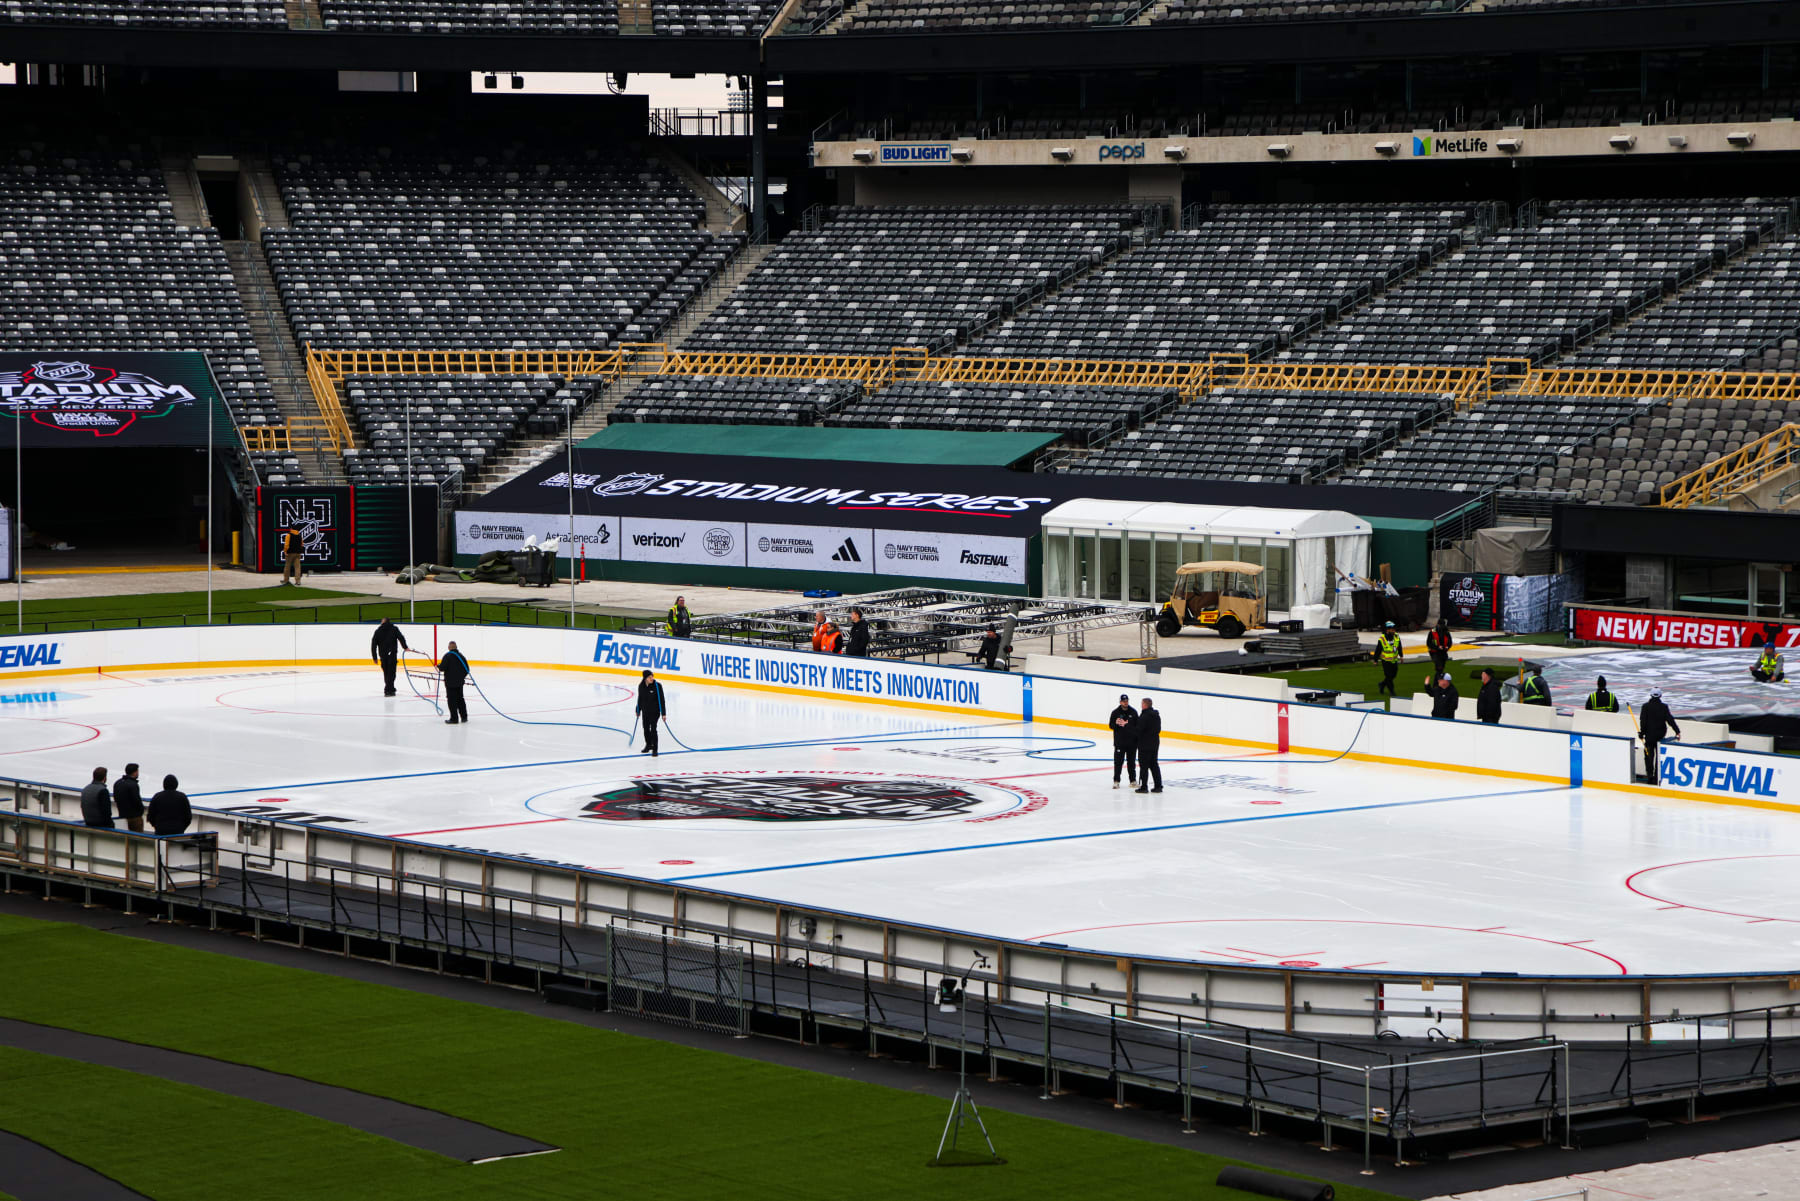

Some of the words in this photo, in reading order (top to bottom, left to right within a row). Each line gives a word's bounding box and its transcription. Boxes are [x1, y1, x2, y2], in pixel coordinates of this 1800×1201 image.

[1099, 142, 1145, 162] pepsi
[1436, 138, 1488, 152] MetLife
[883, 147, 909, 160] BUD
[911, 147, 948, 160] LIGHT
[49, 365, 83, 378] NHL
[0, 396, 161, 405] SERIES
[643, 479, 865, 505] STADIUM
[846, 492, 1051, 511] SERIES
[280, 499, 331, 527] NJ
[633, 532, 680, 548] verizon
[788, 538, 813, 546] FEDERAL
[771, 545, 792, 553] CREDIT
[794, 546, 814, 554] UNION
[896, 544, 912, 552] NAVY
[914, 545, 939, 553] FEDERAL
[960, 549, 1009, 567] FASTENAL
[1448, 589, 1485, 601] STADIUM
[1596, 616, 1649, 641] NEW
[1654, 621, 1747, 647] JERSEY
[593, 633, 680, 671] FASTENAL
[701, 653, 751, 679] WHERE
[755, 659, 828, 688] INDUSTRY
[832, 666, 882, 694] MEETS
[887, 672, 980, 705] INNOVATION
